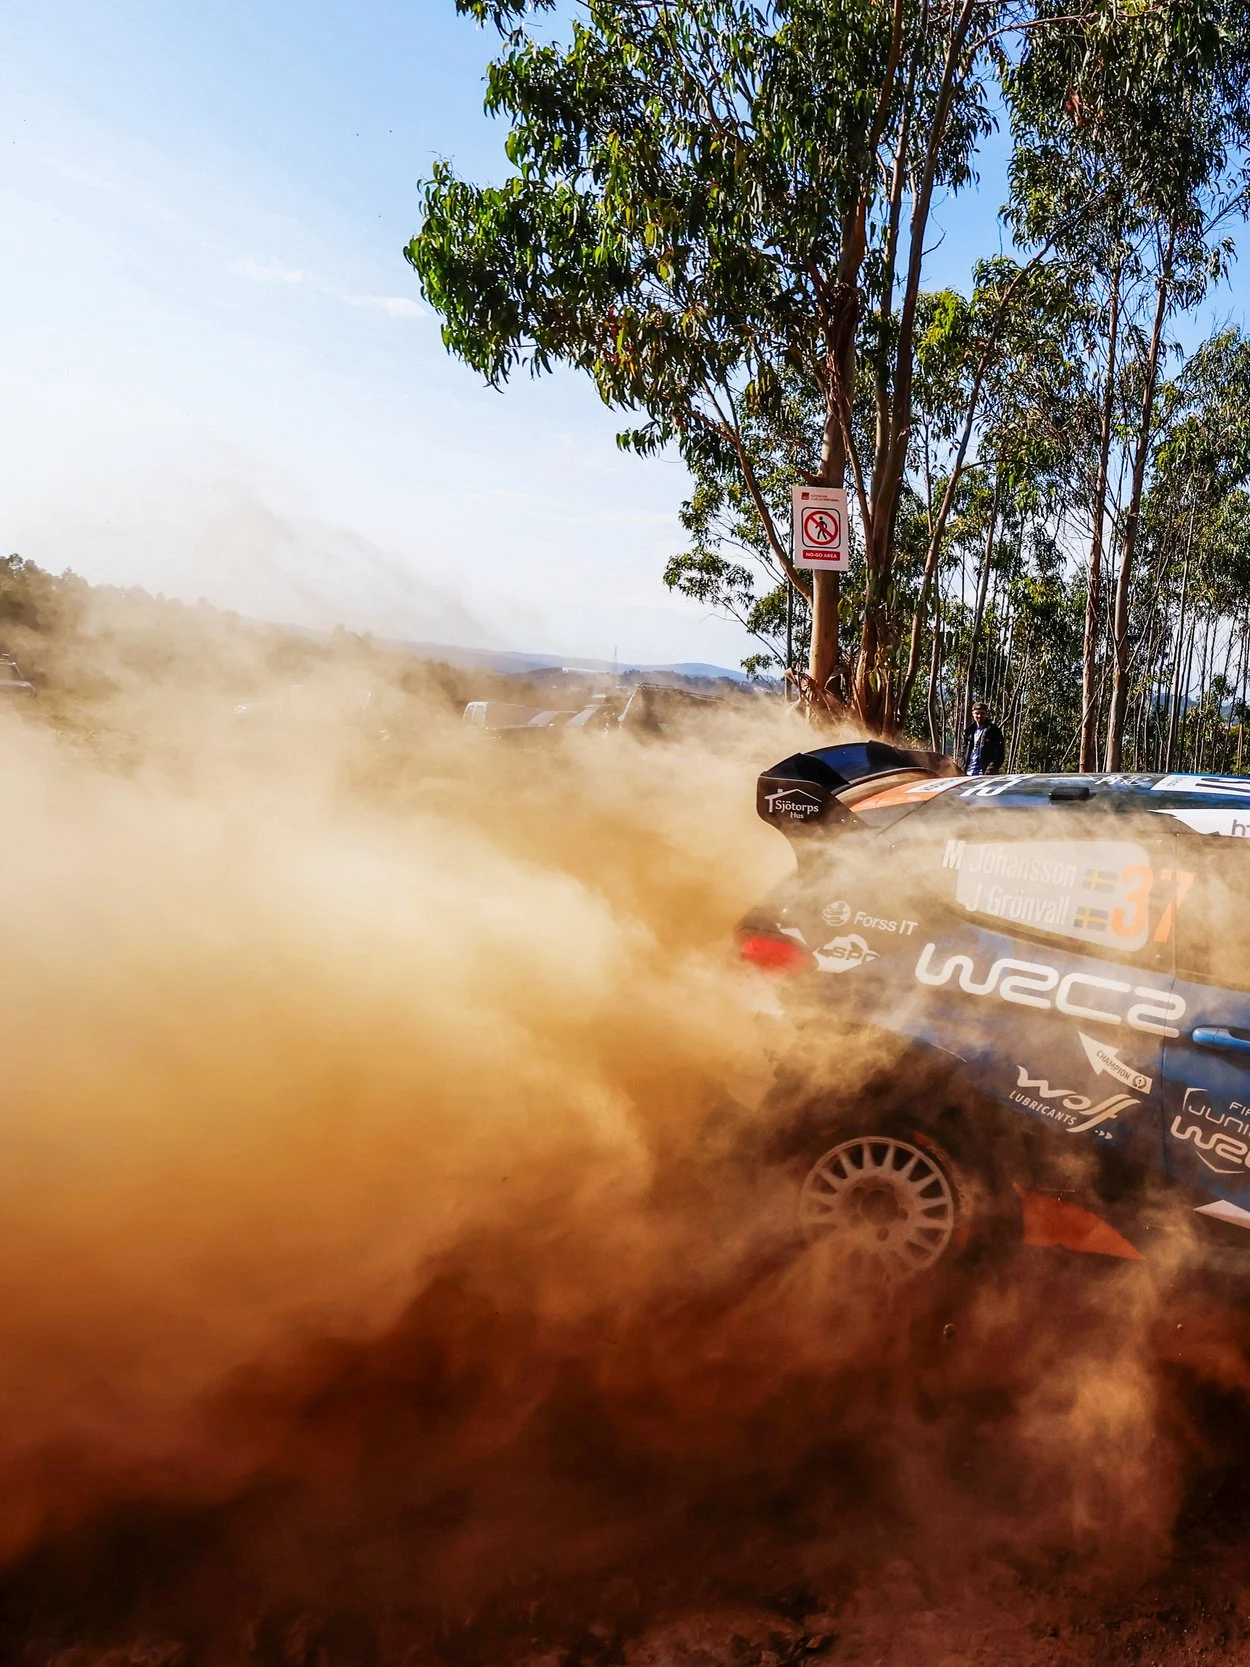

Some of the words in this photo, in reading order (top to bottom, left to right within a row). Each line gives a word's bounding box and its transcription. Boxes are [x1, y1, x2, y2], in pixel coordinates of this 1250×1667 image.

[775, 799, 819, 814] Sjötorps
[790, 810, 805, 819] Hus
[942, 839, 966, 870] M
[969, 846, 1077, 888] Johansson
[964, 883, 983, 912] J
[986, 884, 1071, 927] Grönvall
[1110, 864, 1196, 944] 37
[854, 911, 897, 932] Forss
[899, 919, 918, 936] IT
[915, 943, 1187, 1039] WRC2
[1096, 1050, 1131, 1080] CHAMPION
[1009, 1090, 1077, 1126] LUBRICANTS
